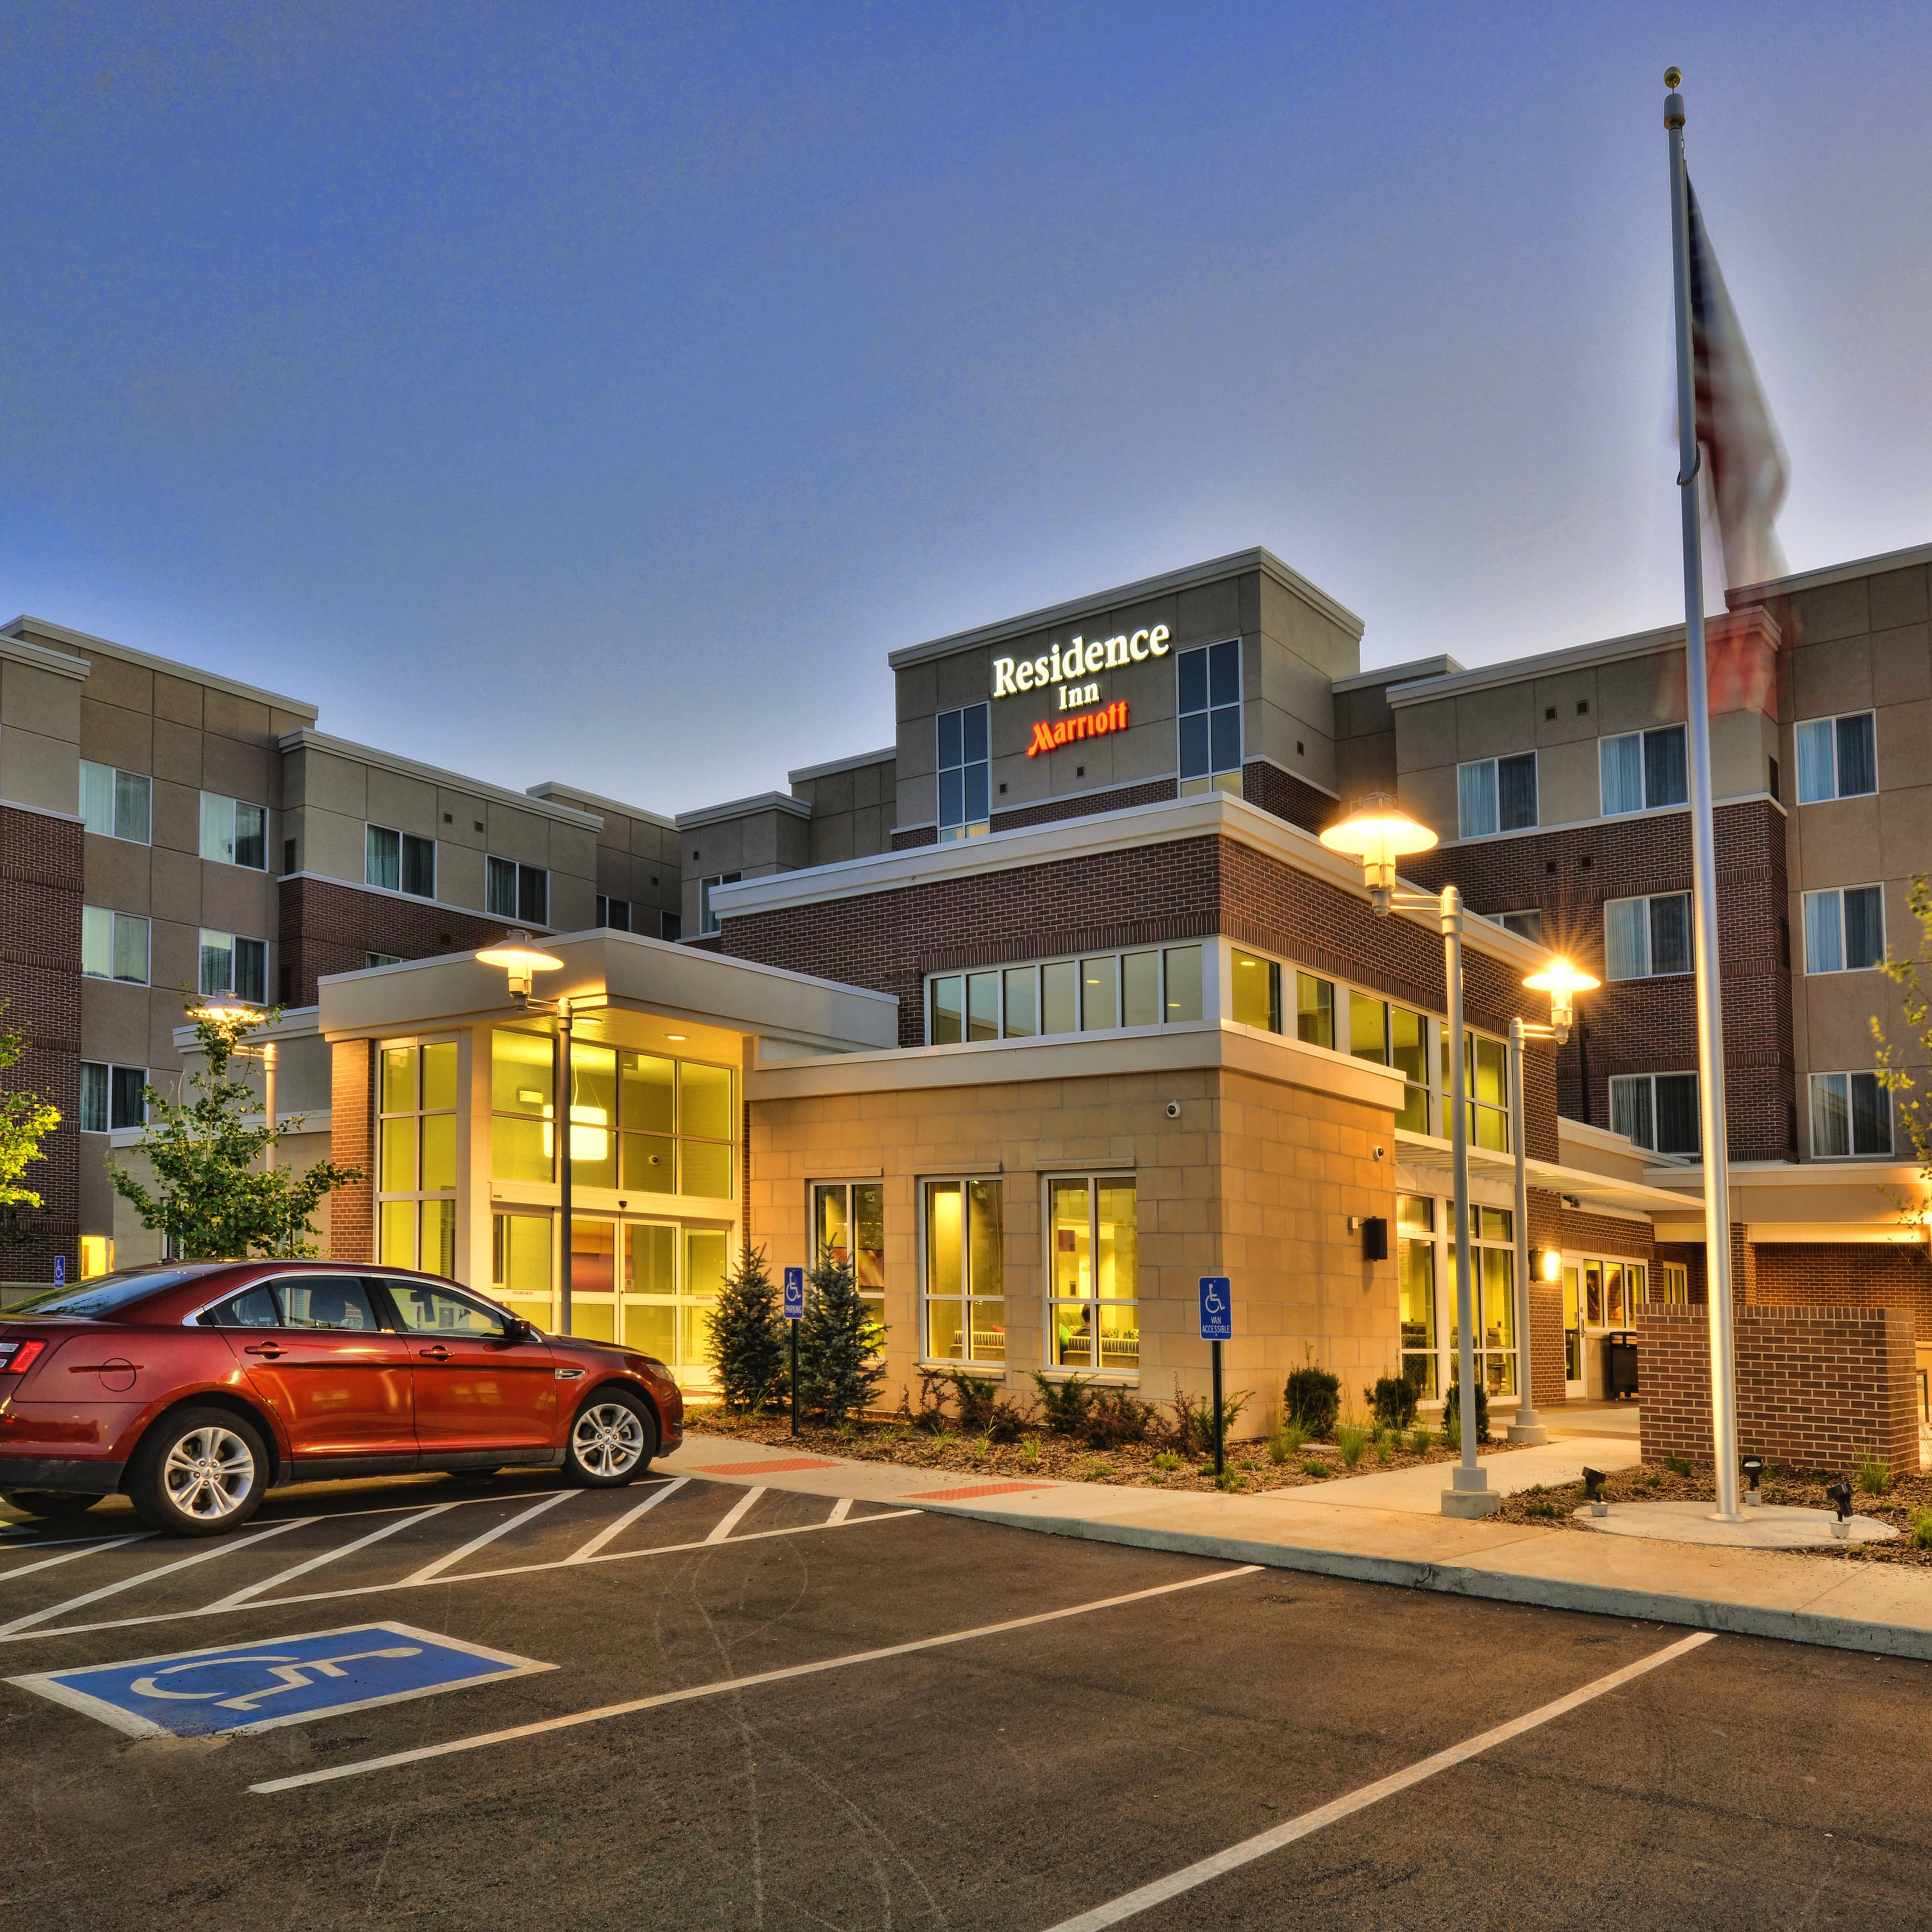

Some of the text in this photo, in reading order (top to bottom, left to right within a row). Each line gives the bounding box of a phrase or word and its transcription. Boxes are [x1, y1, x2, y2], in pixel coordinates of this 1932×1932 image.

[993, 623, 1171, 698] Residence
[1059, 682, 1101, 710] Inn
[1027, 700, 1129, 757] Marriott
[785, 1305, 801, 1314] PARKING
[1202, 1325, 1231, 1333] ACCESSIBLE
[1210, 1316, 1222, 1325] VAN
